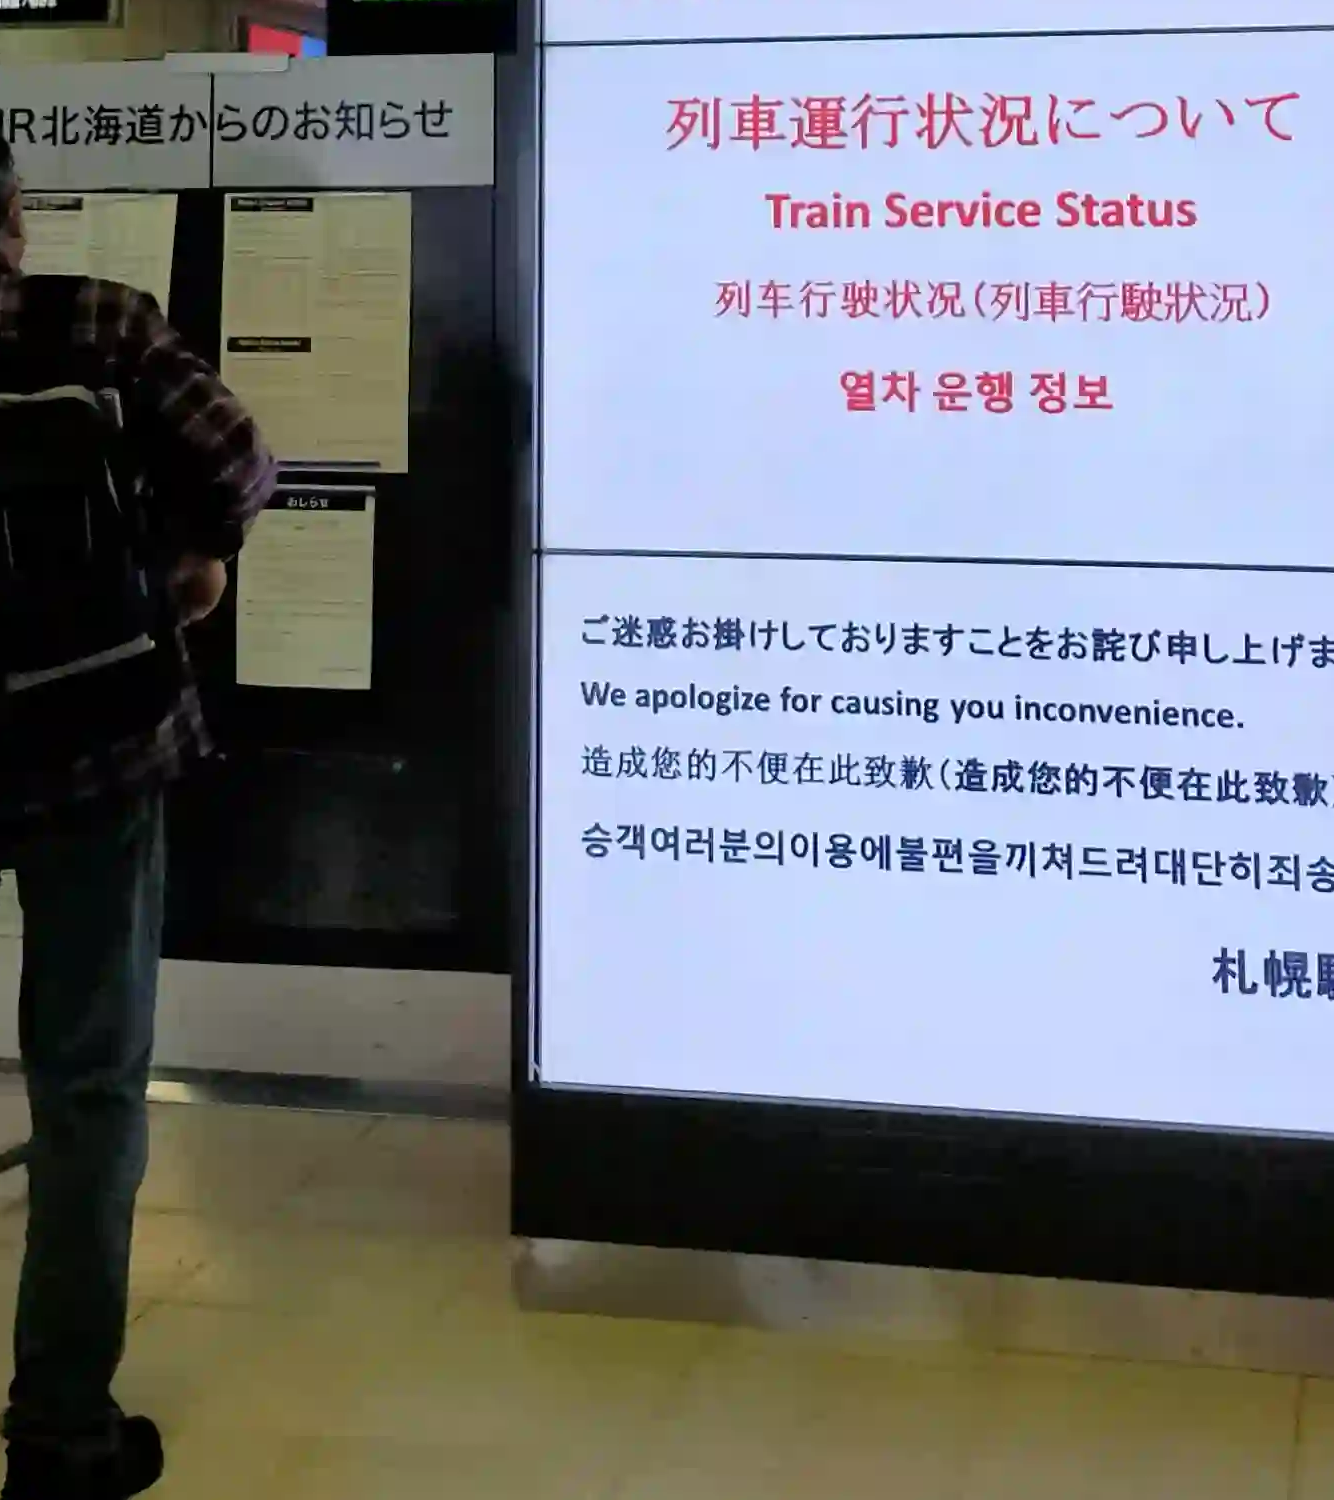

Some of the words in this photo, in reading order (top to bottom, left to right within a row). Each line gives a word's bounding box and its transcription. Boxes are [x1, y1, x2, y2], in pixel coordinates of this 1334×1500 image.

[665, 91, 1301, 152] 列車運行状況について
[765, 192, 871, 229] Train
[884, 190, 1041, 229] Service
[1055, 190, 1198, 229] Status
[839, 370, 922, 414] 열차
[932, 370, 1016, 414] 운행
[1029, 370, 1114, 414] 정보
[581, 680, 627, 709] We
[635, 682, 771, 718] apologize
[779, 685, 823, 713] for
[830, 689, 940, 724] causing
[950, 699, 1005, 726] you
[1014, 694, 1245, 730] inconvenience.
